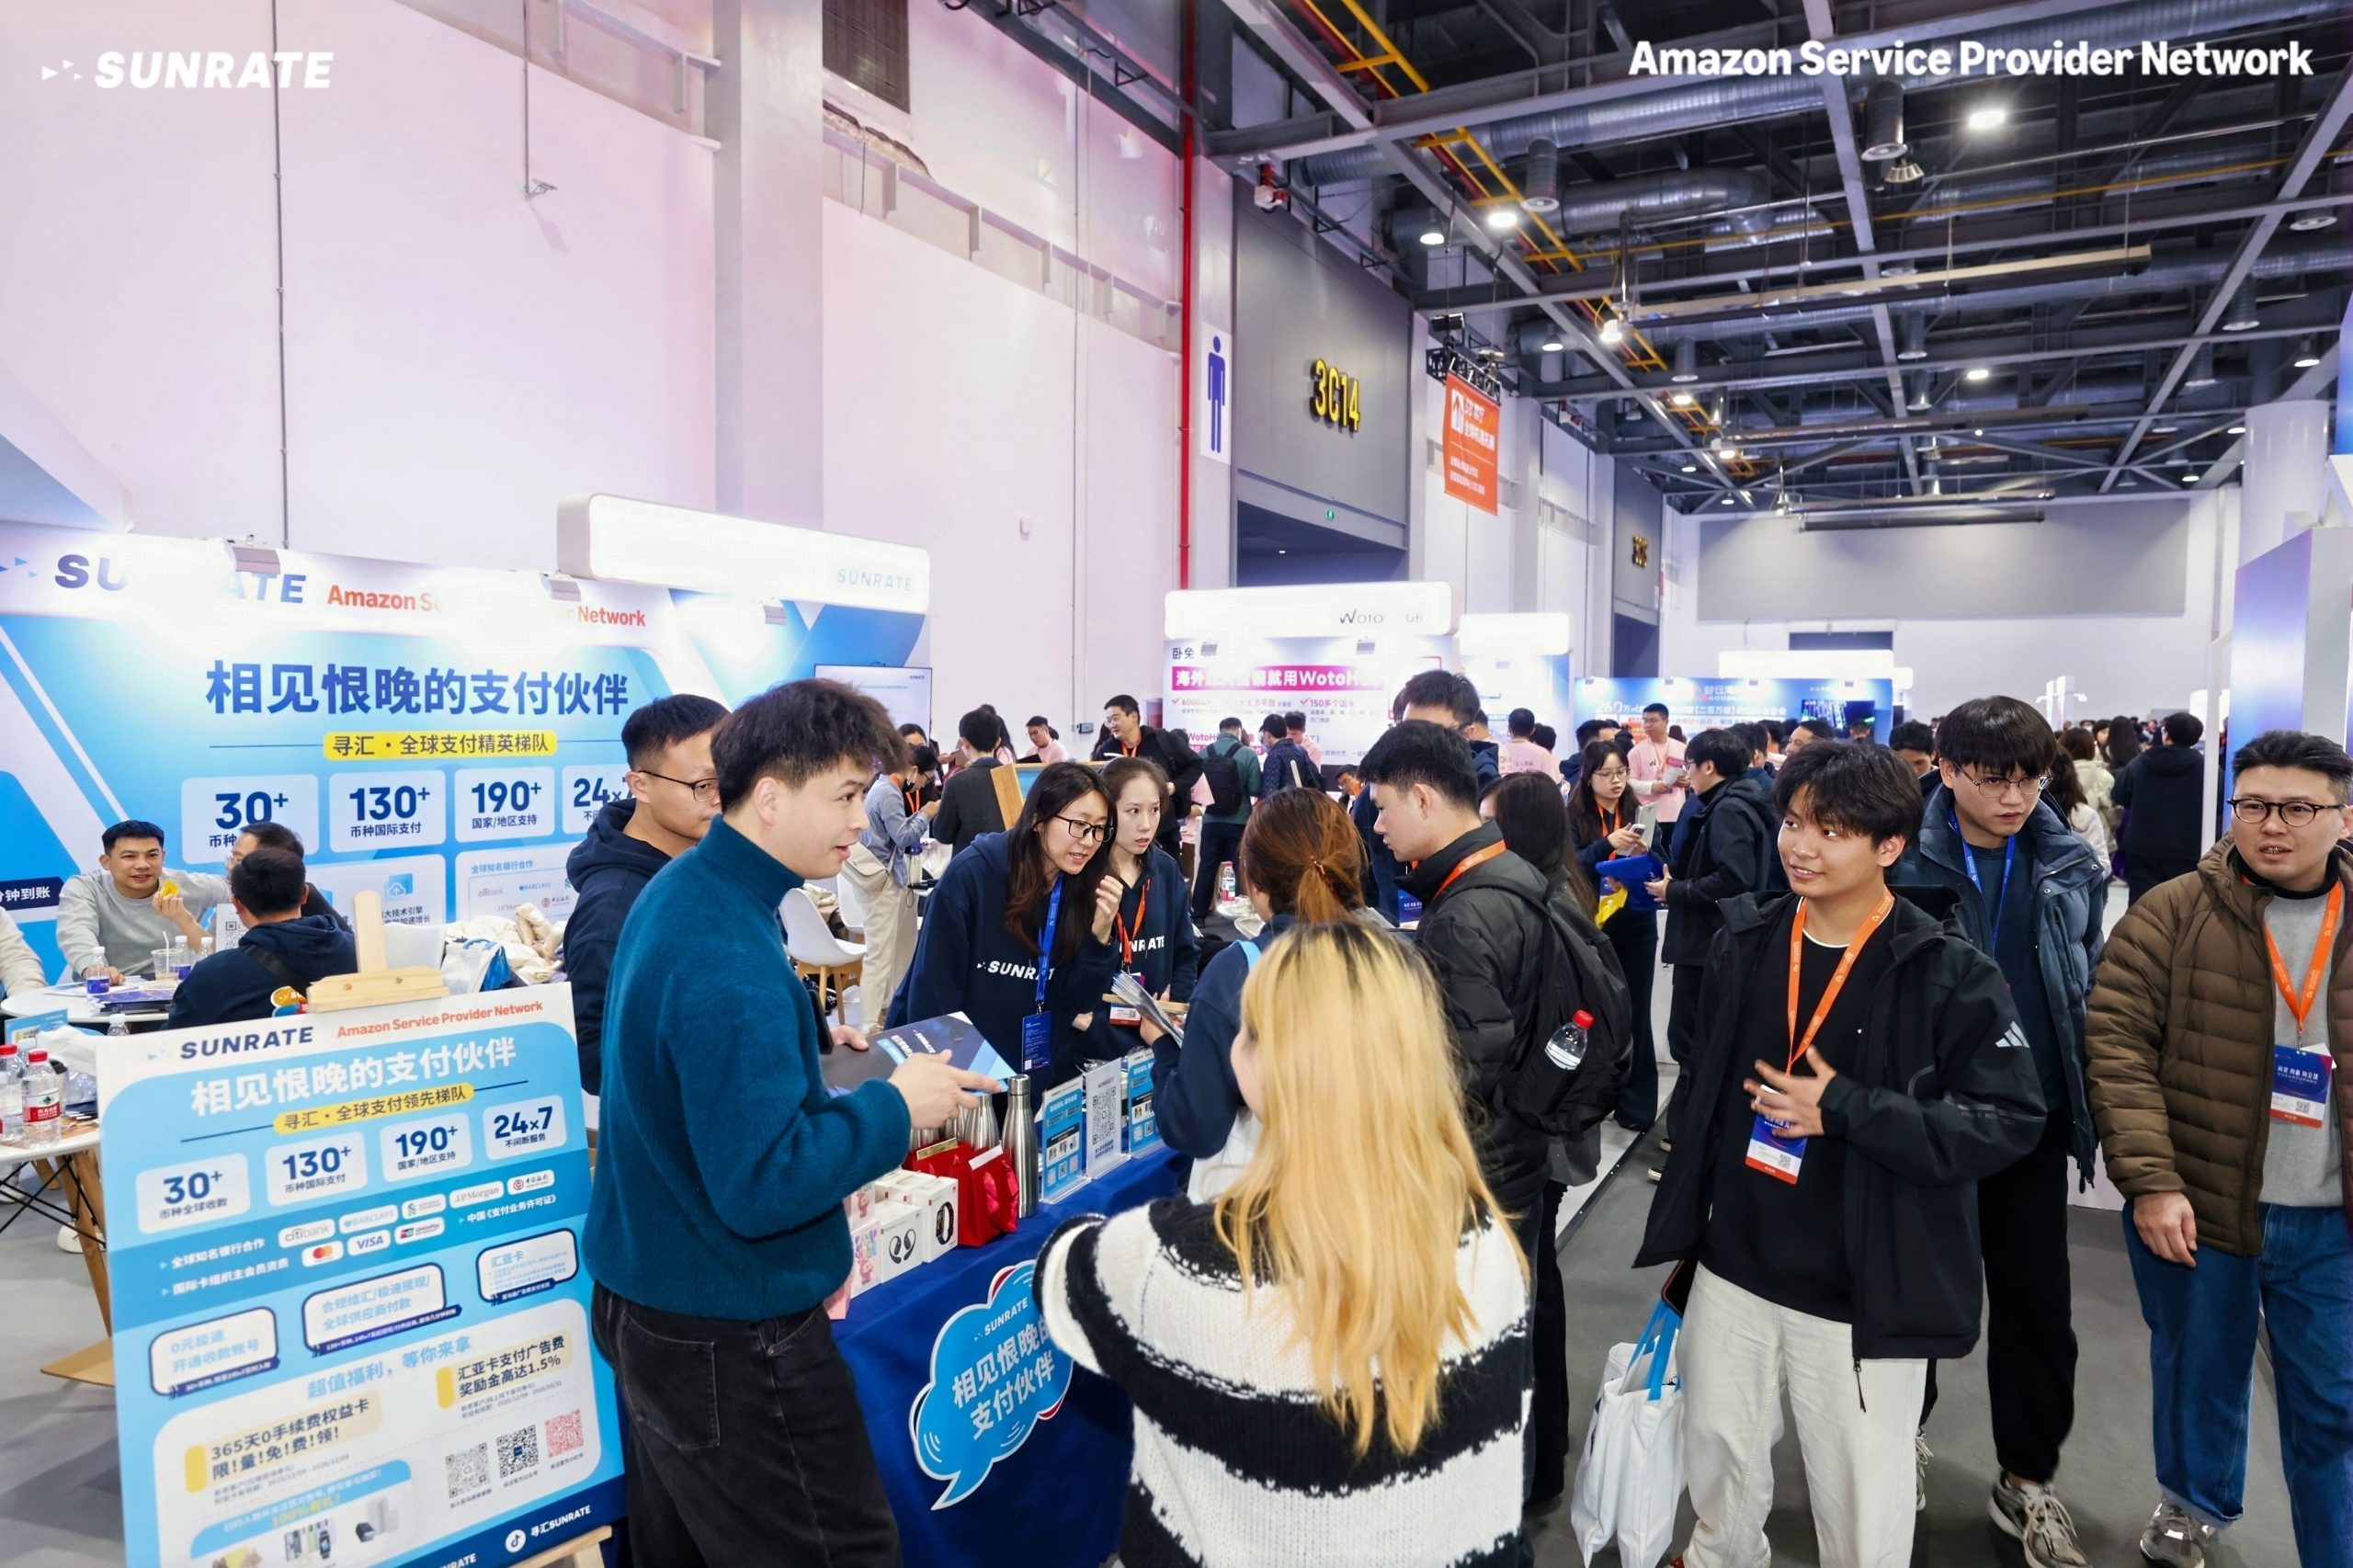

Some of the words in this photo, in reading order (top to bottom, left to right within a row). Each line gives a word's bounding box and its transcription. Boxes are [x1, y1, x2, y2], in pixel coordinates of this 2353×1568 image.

[1313, 359, 1359, 432] 3C14
[837, 568, 913, 593] SUNRATE
[326, 584, 415, 611] Amazon
[577, 605, 646, 627] Network
[205, 660, 629, 716] 相见恨晚的支付伙伴
[215, 791, 289, 829] 30+
[349, 786, 430, 821] 130+
[472, 780, 541, 813] 190+
[350, 822, 422, 838] 币种国际支付
[472, 814, 538, 830] 国家/地区支持
[0, 886, 51, 903] 钟到账
[337, 1021, 391, 1039] Amazon
[392, 1016, 440, 1031] Service
[442, 1008, 494, 1025] Provider
[495, 1001, 543, 1018] Network
[181, 1027, 313, 1059] SUNRATE
[191, 1036, 517, 1117] 相见恨晚的支付伙伴
[395, 1126, 458, 1157] 190+
[505, 1132, 546, 1148] 不间断服务
[282, 1146, 351, 1180] 130+
[397, 1151, 456, 1170] 国家/地区支持
[164, 1171, 222, 1204] 30+
[285, 1173, 346, 1193] 币种国际支付
[160, 1198, 228, 1219] 币种全球收款
[172, 1238, 265, 1269] 全球知名银行合作
[357, 1235, 383, 1249] VISA
[983, 1297, 1029, 1336] SUNRATE
[458, 1335, 565, 1381] 汇亚卡支付广告费
[459, 1355, 561, 1398] 奖励金高达1.5%
[970, 1349, 1056, 1440] 支付伙伴
[211, 1399, 369, 1460] 365天0手续费权益卡
